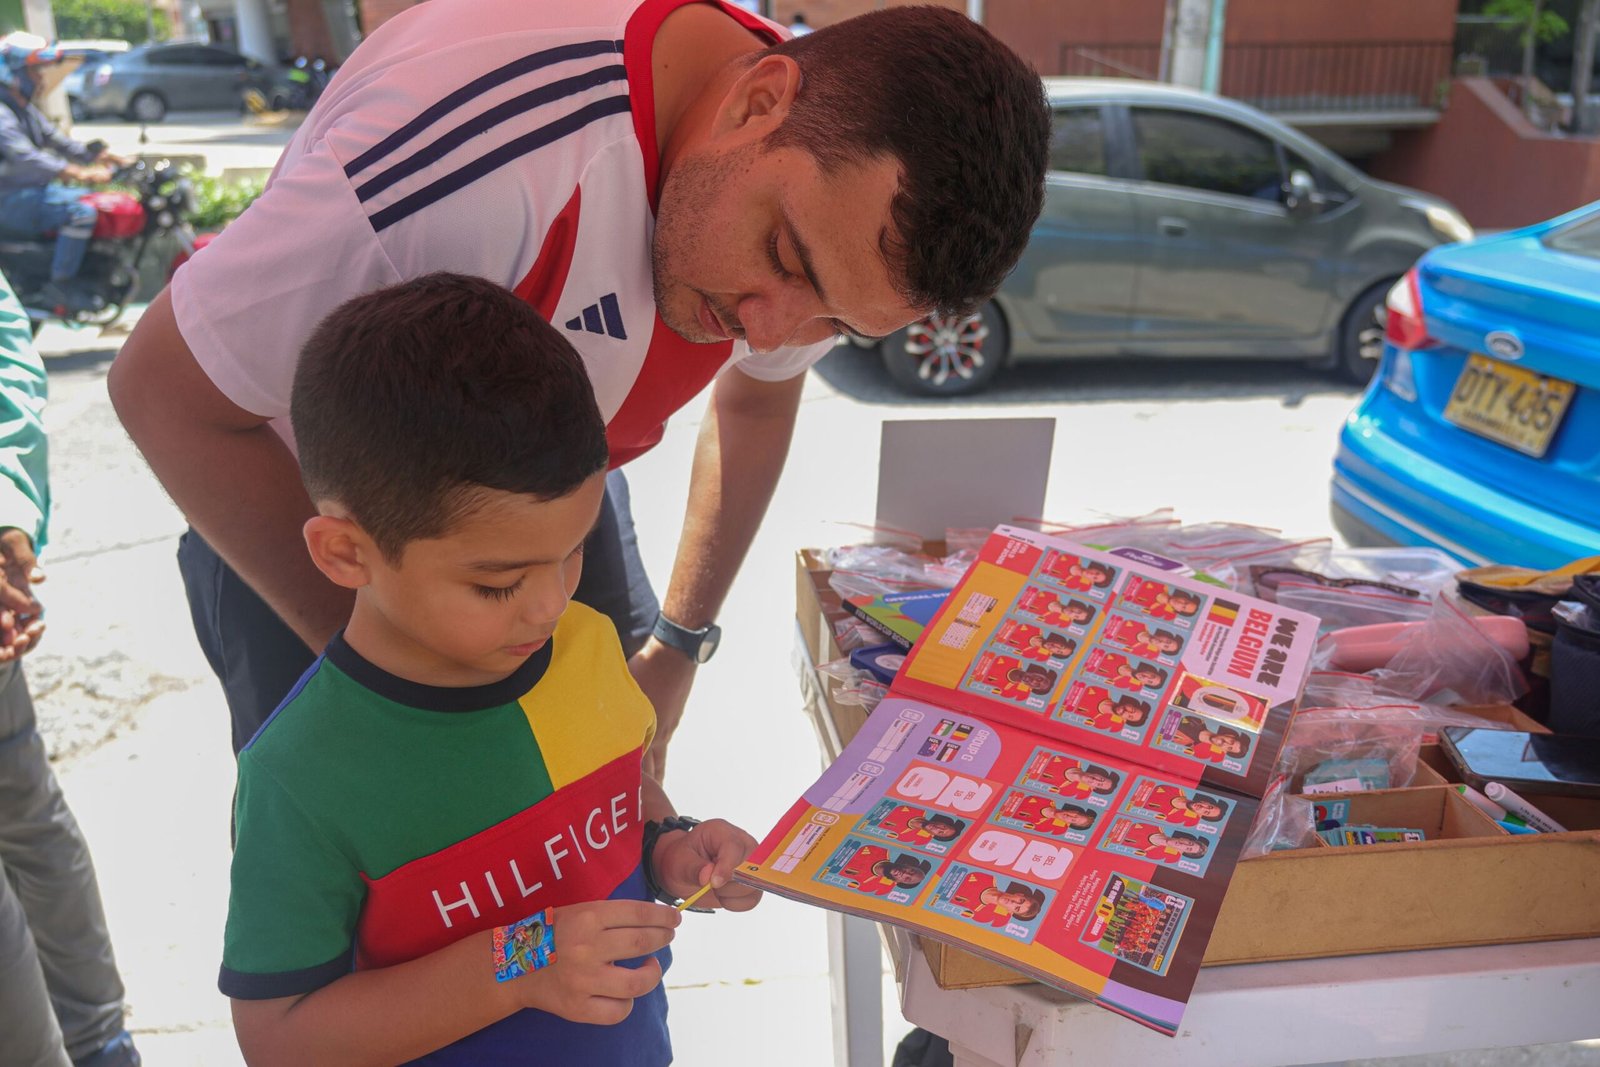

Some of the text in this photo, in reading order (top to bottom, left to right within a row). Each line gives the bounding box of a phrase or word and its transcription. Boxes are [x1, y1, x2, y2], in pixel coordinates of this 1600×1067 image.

[1226, 607, 1273, 679] BELGIUM
[1256, 617, 1299, 688] WE ARE
[961, 729, 990, 762] GROUP G
[964, 791, 977, 801] BEL
[1043, 855, 1056, 867] BEL
